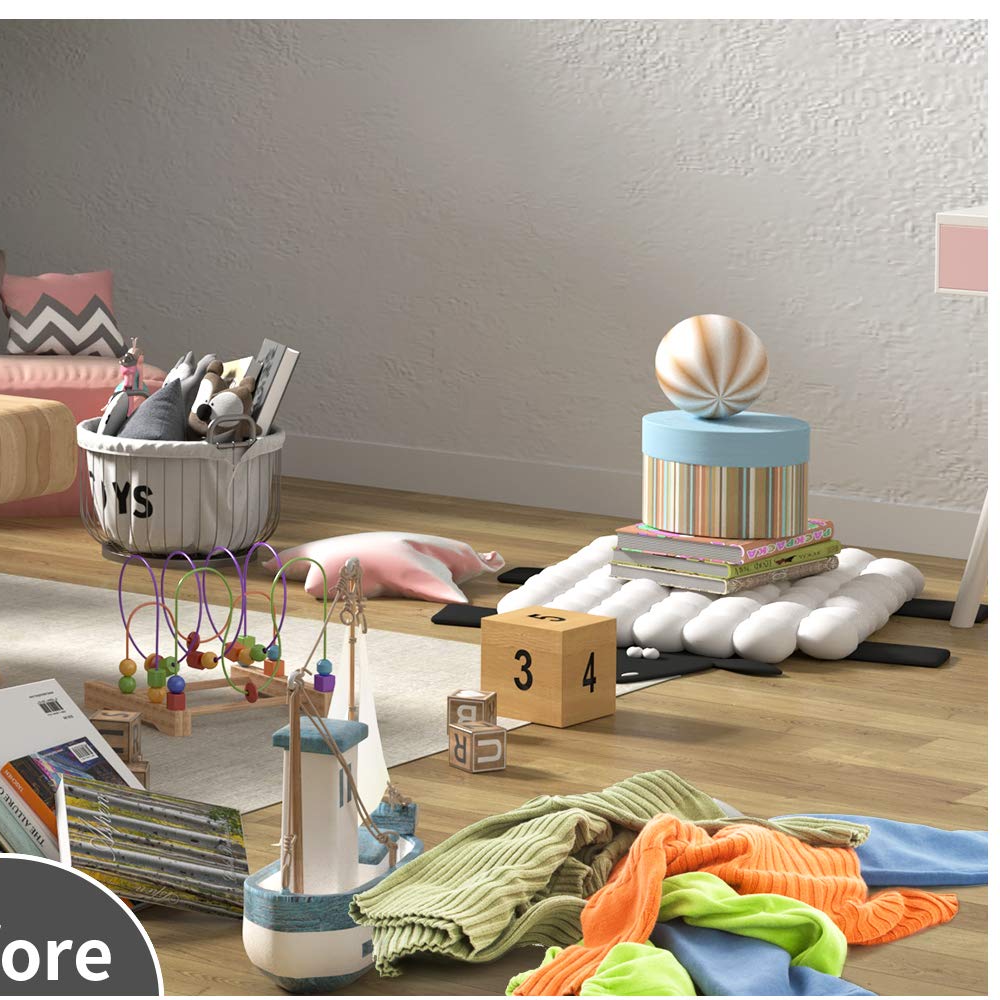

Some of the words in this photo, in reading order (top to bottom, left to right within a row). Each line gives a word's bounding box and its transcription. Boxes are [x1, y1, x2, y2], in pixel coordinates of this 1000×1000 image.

[514, 649, 533, 691] 3
[582, 651, 597, 693] 4
[454, 733, 467, 764] R
[4, 769, 24, 793] TASCHEN
[4, 791, 31, 830] ALLURE
[29, 828, 45, 847] THE
